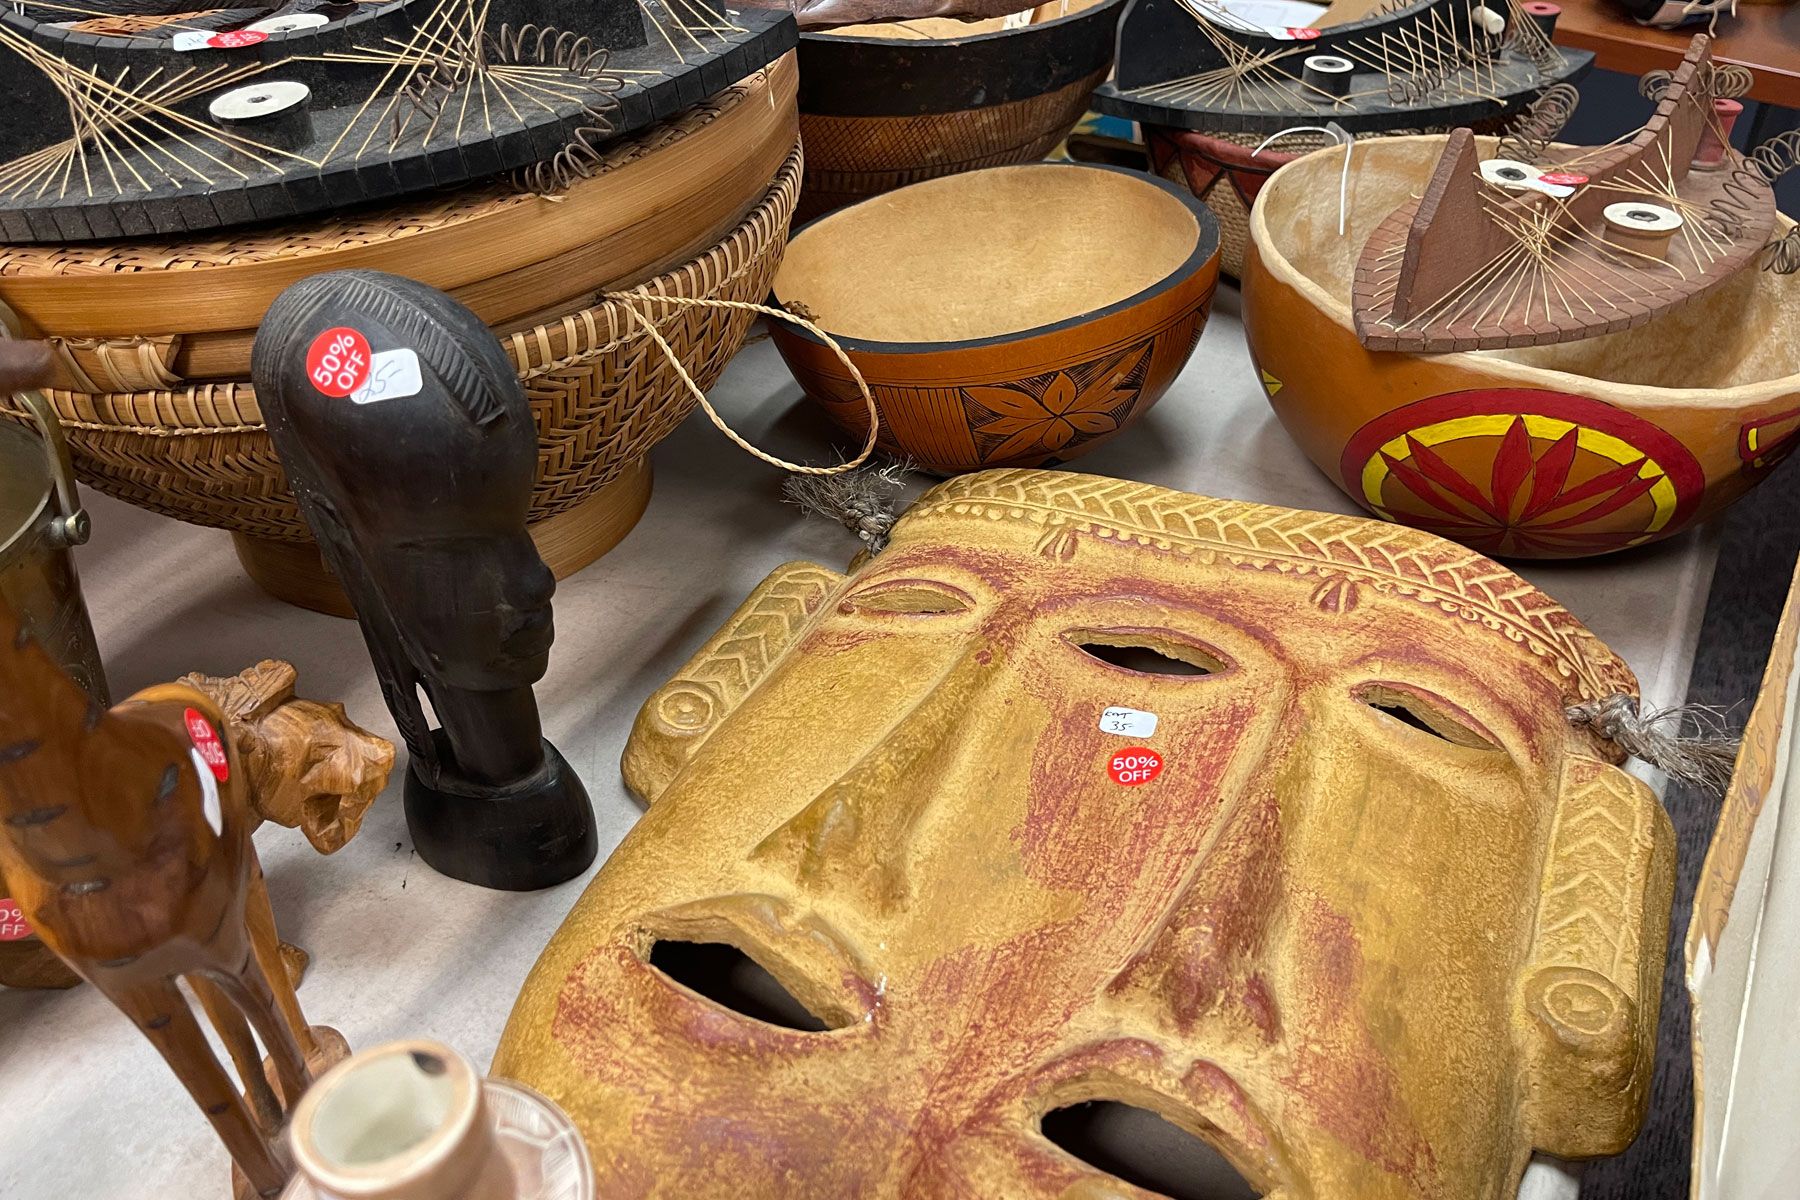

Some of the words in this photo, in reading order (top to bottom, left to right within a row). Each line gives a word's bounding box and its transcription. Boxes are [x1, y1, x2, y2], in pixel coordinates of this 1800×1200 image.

[313, 334, 356, 387] 50%
[336, 349, 365, 390] OFF
[1112, 755, 1159, 771] 50%
[1119, 769, 1152, 783] OFF
[1, 923, 25, 936] FF
